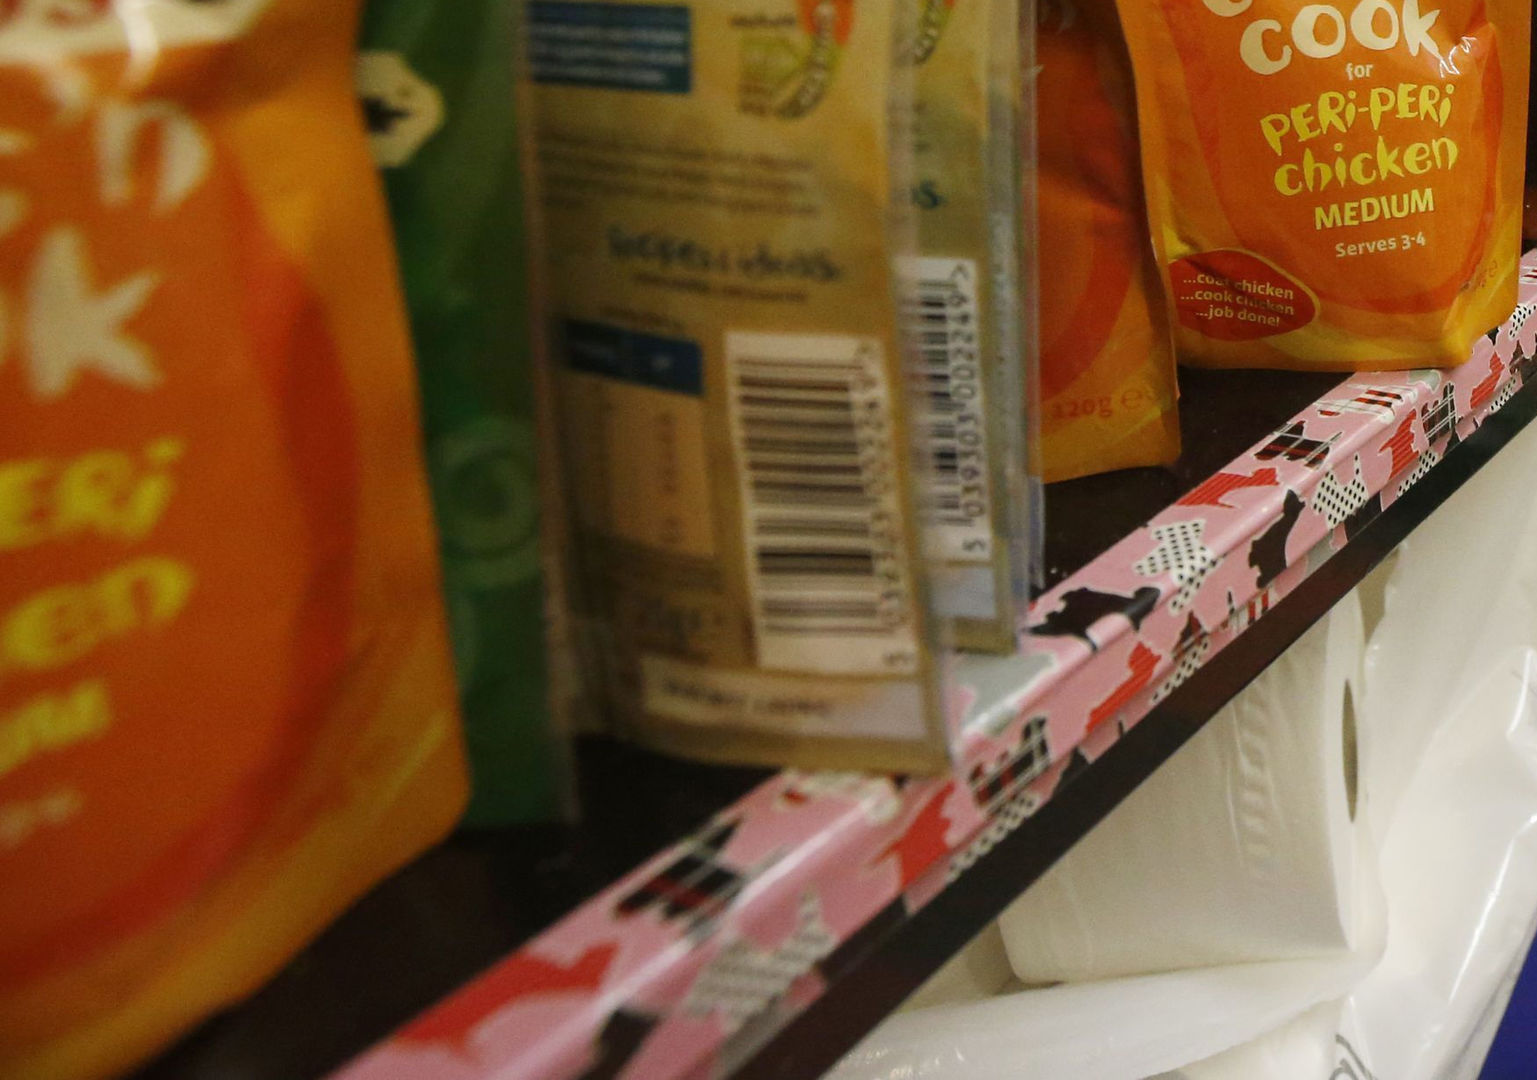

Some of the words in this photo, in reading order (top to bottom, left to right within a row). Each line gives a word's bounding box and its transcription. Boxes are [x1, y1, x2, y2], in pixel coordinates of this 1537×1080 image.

[1346, 63, 1374, 81] for
[1260, 83, 1454, 156] PERi-PERi
[1274, 136, 1458, 196] chicken
[1314, 188, 1434, 230] MEDIUM
[1335, 235, 1397, 259] Serves
[1401, 232, 1426, 250] 3-4
[1196, 305, 1234, 320] ...job
[1237, 309, 1281, 327] done!
